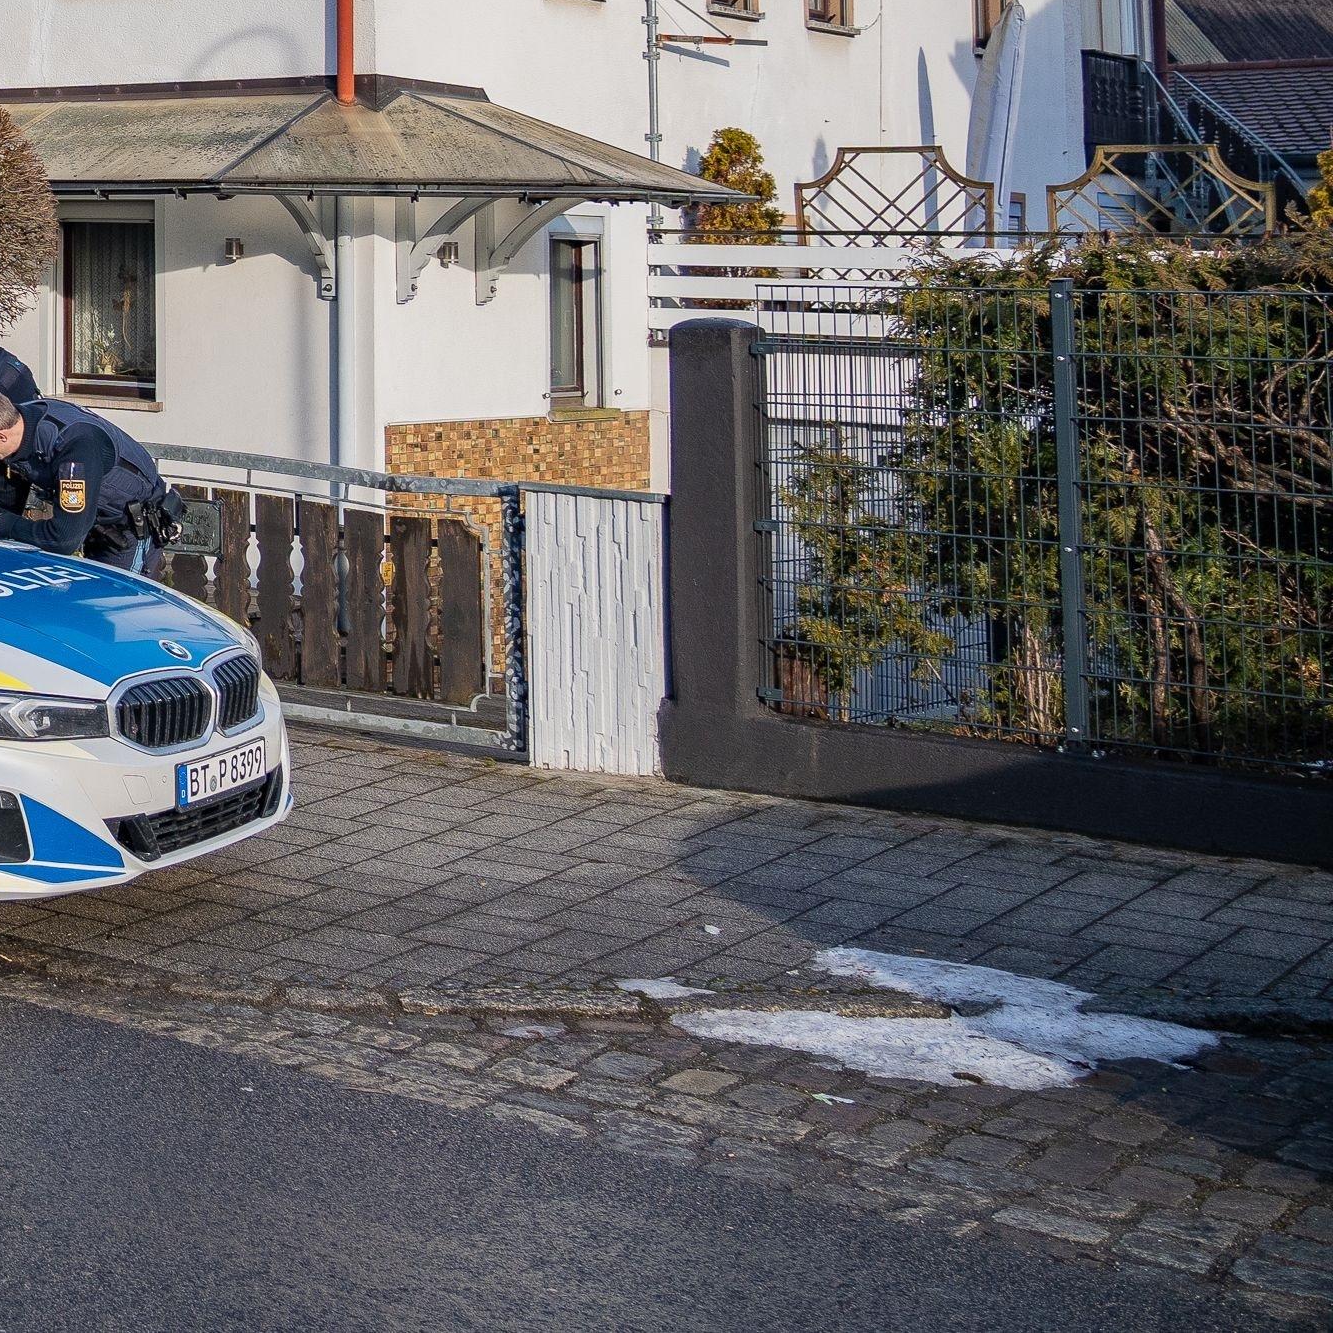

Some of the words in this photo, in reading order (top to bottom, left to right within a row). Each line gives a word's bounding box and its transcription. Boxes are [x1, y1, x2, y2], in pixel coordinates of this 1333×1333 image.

[190, 764, 210, 797] BT
[219, 758, 227, 788] P
[230, 745, 262, 784] 8399
